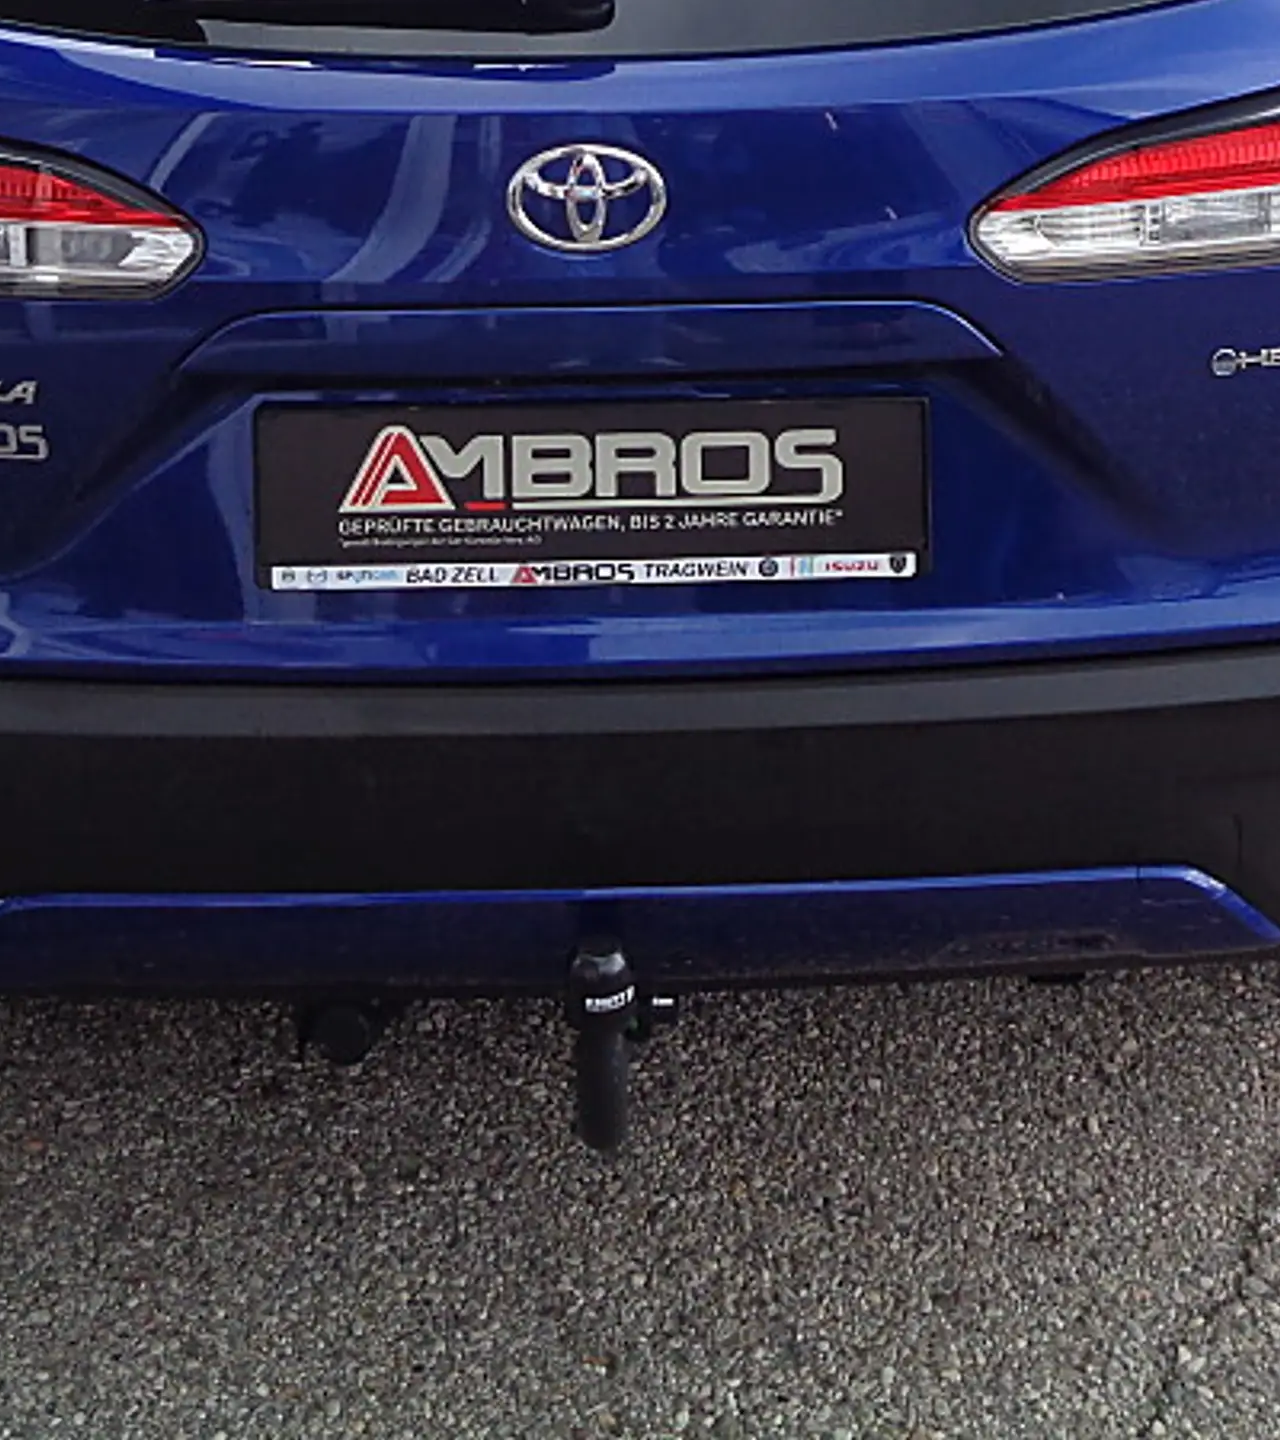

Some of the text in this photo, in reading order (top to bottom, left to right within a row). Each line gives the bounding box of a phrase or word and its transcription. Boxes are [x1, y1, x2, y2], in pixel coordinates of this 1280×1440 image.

[339, 425, 844, 511] AMBROS
[338, 515, 434, 536] GEPRÜFTE
[630, 513, 661, 530] BIS
[664, 513, 678, 530] 2
[679, 511, 738, 530] JAHRE
[407, 565, 447, 584] BAD
[451, 565, 499, 584] ZELL
[511, 563, 636, 583] AMBROS
[644, 561, 749, 579] TRAGWEIN
